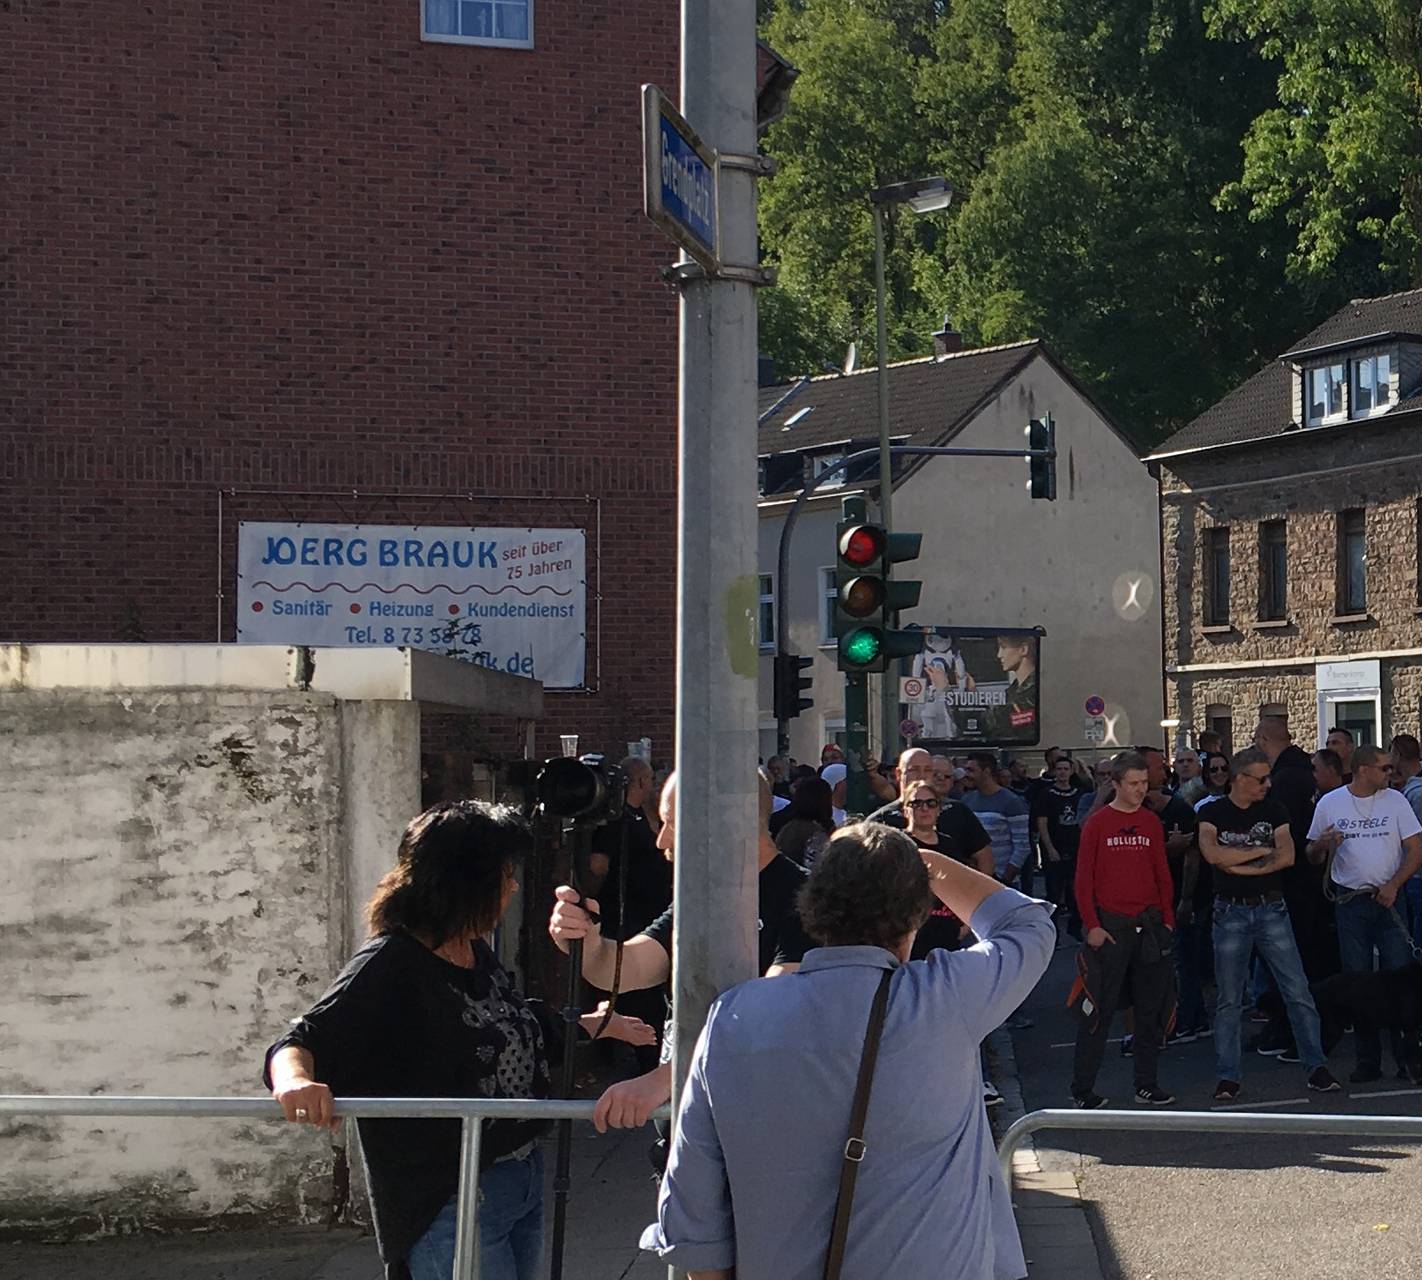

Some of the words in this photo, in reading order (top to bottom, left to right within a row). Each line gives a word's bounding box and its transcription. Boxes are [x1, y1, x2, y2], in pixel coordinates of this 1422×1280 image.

[261, 536, 368, 566] JOERG
[379, 538, 498, 568] BRAUK
[501, 543, 528, 562] seit
[530, 537, 564, 556] über
[505, 564, 524, 581] 75
[526, 556, 573, 578] Jahren
[271, 599, 334, 618] Sanitär
[368, 600, 435, 618] Heizung
[467, 601, 576, 619] Kundendienst
[344, 625, 378, 645] Tel.
[383, 627, 396, 644] 8
[400, 627, 424, 645] 73
[907, 683, 919, 693] 30
[946, 690, 1007, 706] STUDIEREN
[1348, 816, 1389, 829] STEELE
[1106, 835, 1151, 847] HOLLISTER
